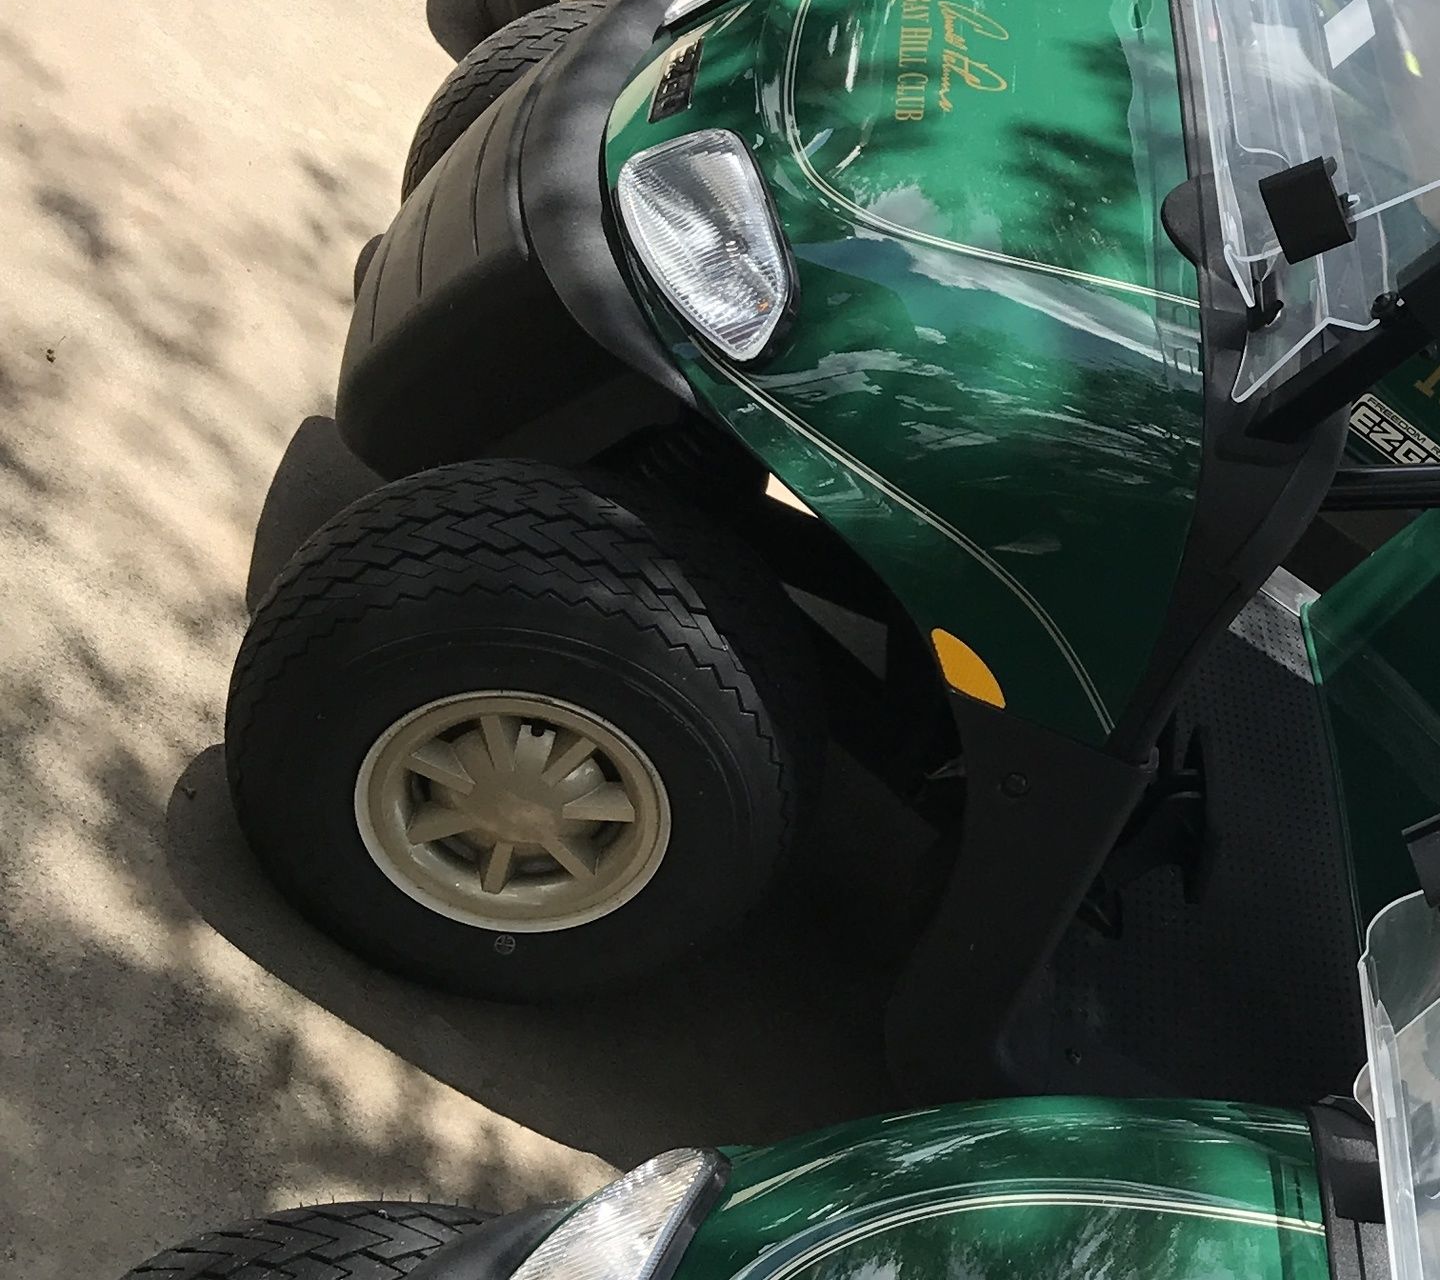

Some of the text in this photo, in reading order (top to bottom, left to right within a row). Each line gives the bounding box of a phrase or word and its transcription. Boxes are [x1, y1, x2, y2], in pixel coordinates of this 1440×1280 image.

[900, 26, 932, 68] HILL
[895, 72, 928, 120] CLUB
[1367, 396, 1428, 445] FREEDOM
